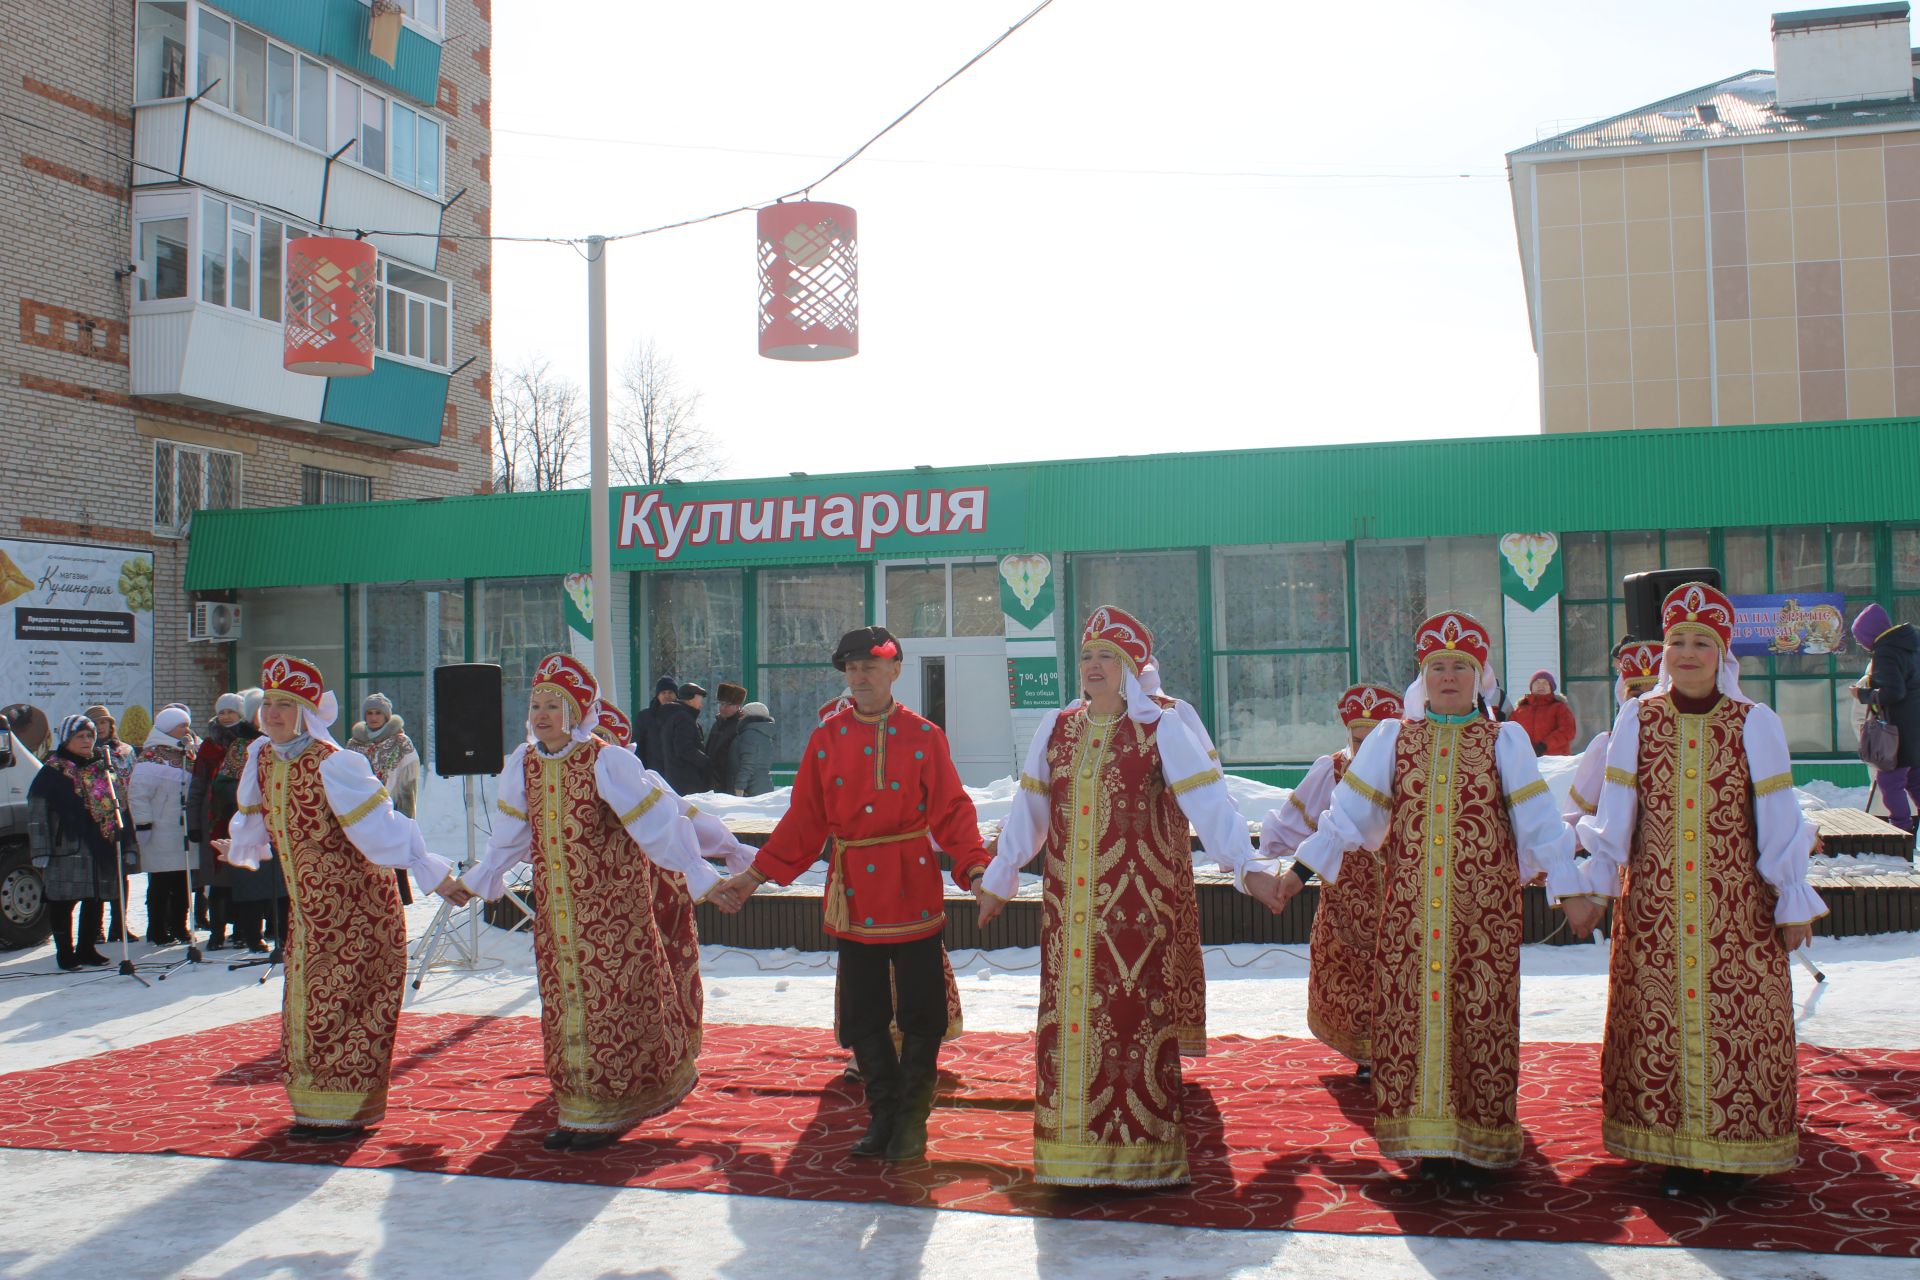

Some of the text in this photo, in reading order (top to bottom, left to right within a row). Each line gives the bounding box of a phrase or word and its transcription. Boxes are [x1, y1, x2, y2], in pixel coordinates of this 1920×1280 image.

[617, 486, 988, 561] Кулинария
[38, 564, 113, 606] Кулинария
[59, 572, 88, 580] магазин
[1752, 612, 1769, 623] НА
